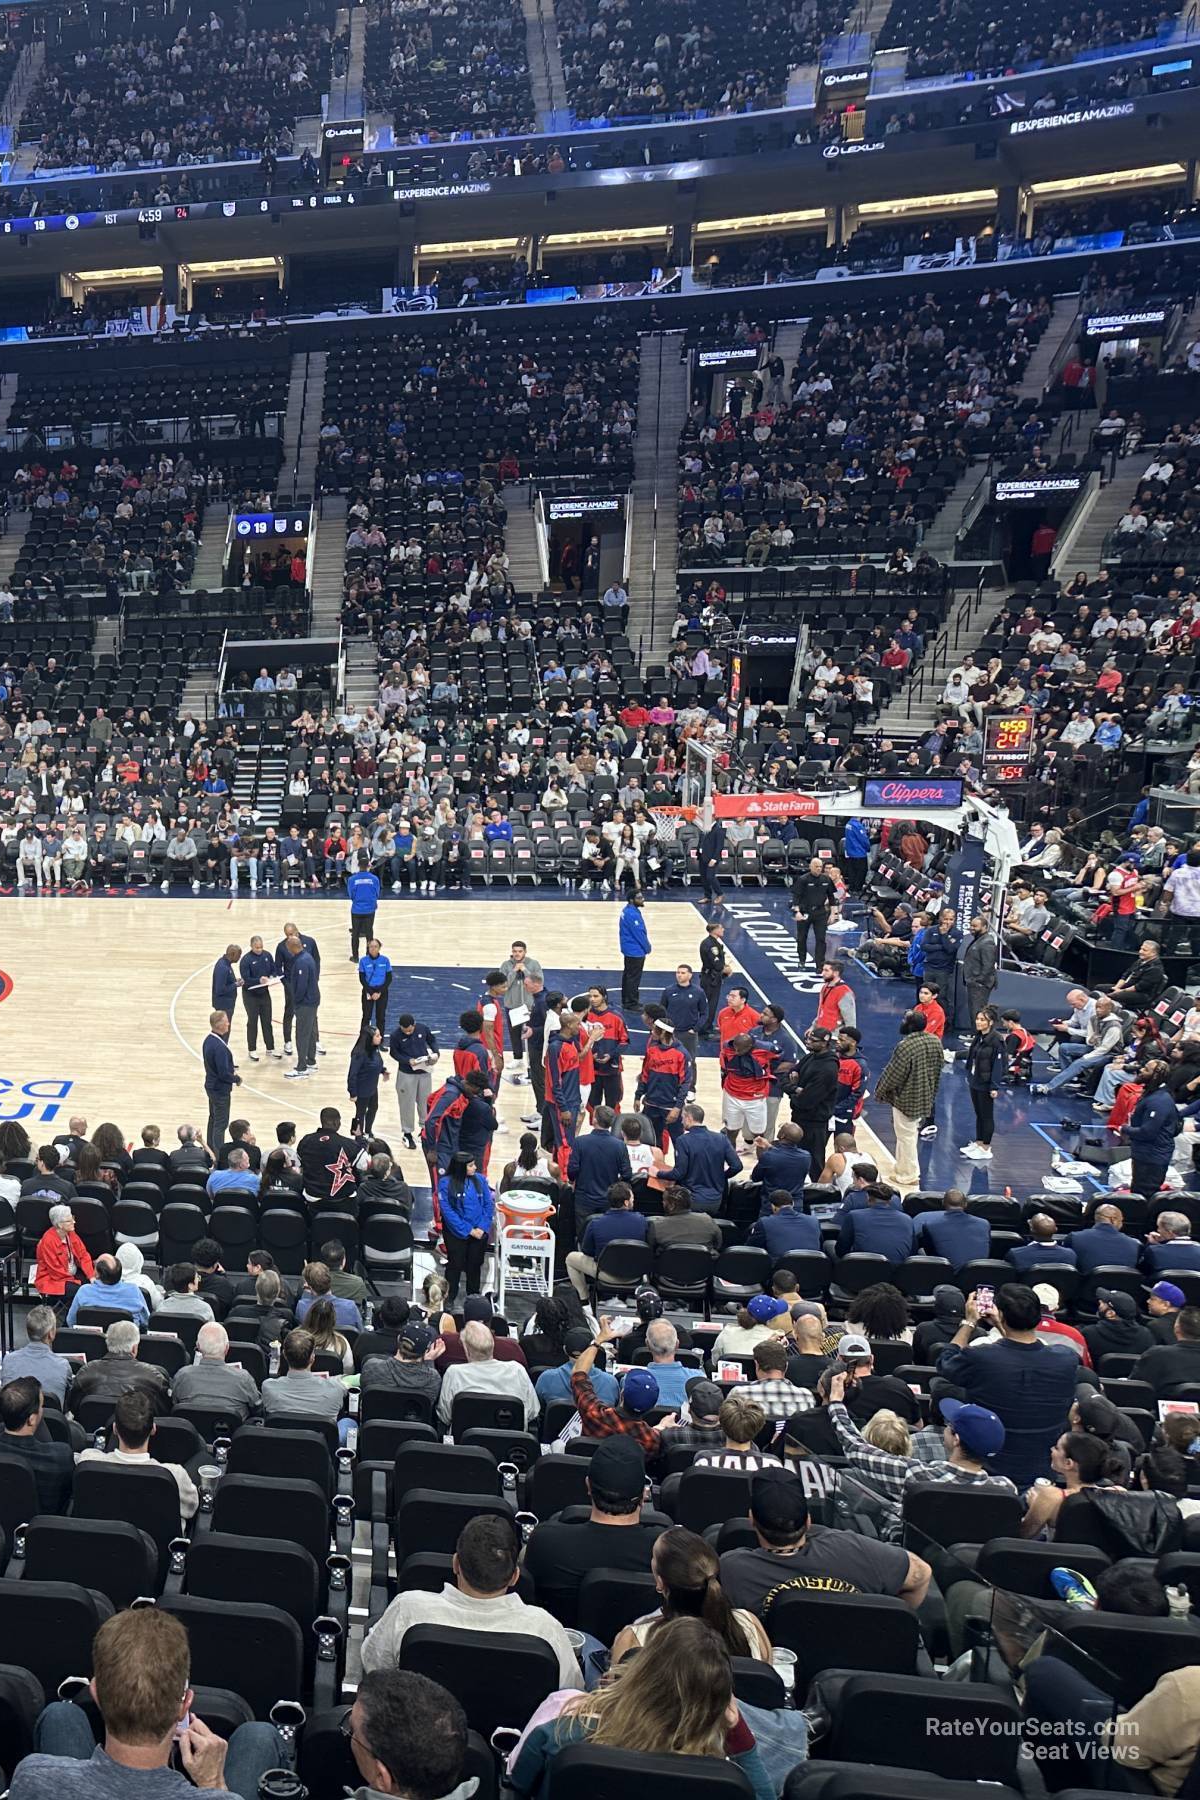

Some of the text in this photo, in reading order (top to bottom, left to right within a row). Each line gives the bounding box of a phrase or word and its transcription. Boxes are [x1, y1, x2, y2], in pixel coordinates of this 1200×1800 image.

[836, 72, 868, 82] LEXUS
[1018, 104, 1134, 132] EXPERIENCE AMAZING
[840, 142, 886, 154] LEXUS
[399, 184, 491, 198] EXPERIENCE AMAZING
[310, 196, 316, 207] 6
[348, 194, 354, 204] 4
[260, 201, 268, 211] 8
[138, 210, 162, 222] 4:59
[176, 208, 187, 218] 24
[104, 214, 118, 224] 1ST
[4, 222, 11, 232] 6
[34, 220, 46, 230] 19
[1088, 311, 1164, 326] EXPERIENCE AMAZING
[700, 351, 731, 360] EXPERIENCE
[996, 479, 1080, 490] EXPERIENCE AMAZING
[254, 522, 267, 533] 19
[294, 520, 302, 531] 8
[996, 733, 1020, 748] 24
[881, 783, 944, 801] Clippers
[762, 800, 815, 812] State Farm
[958, 884, 966, 910] RESORT
[722, 903, 772, 919] LA
[962, 884, 974, 936] PECHANGA
